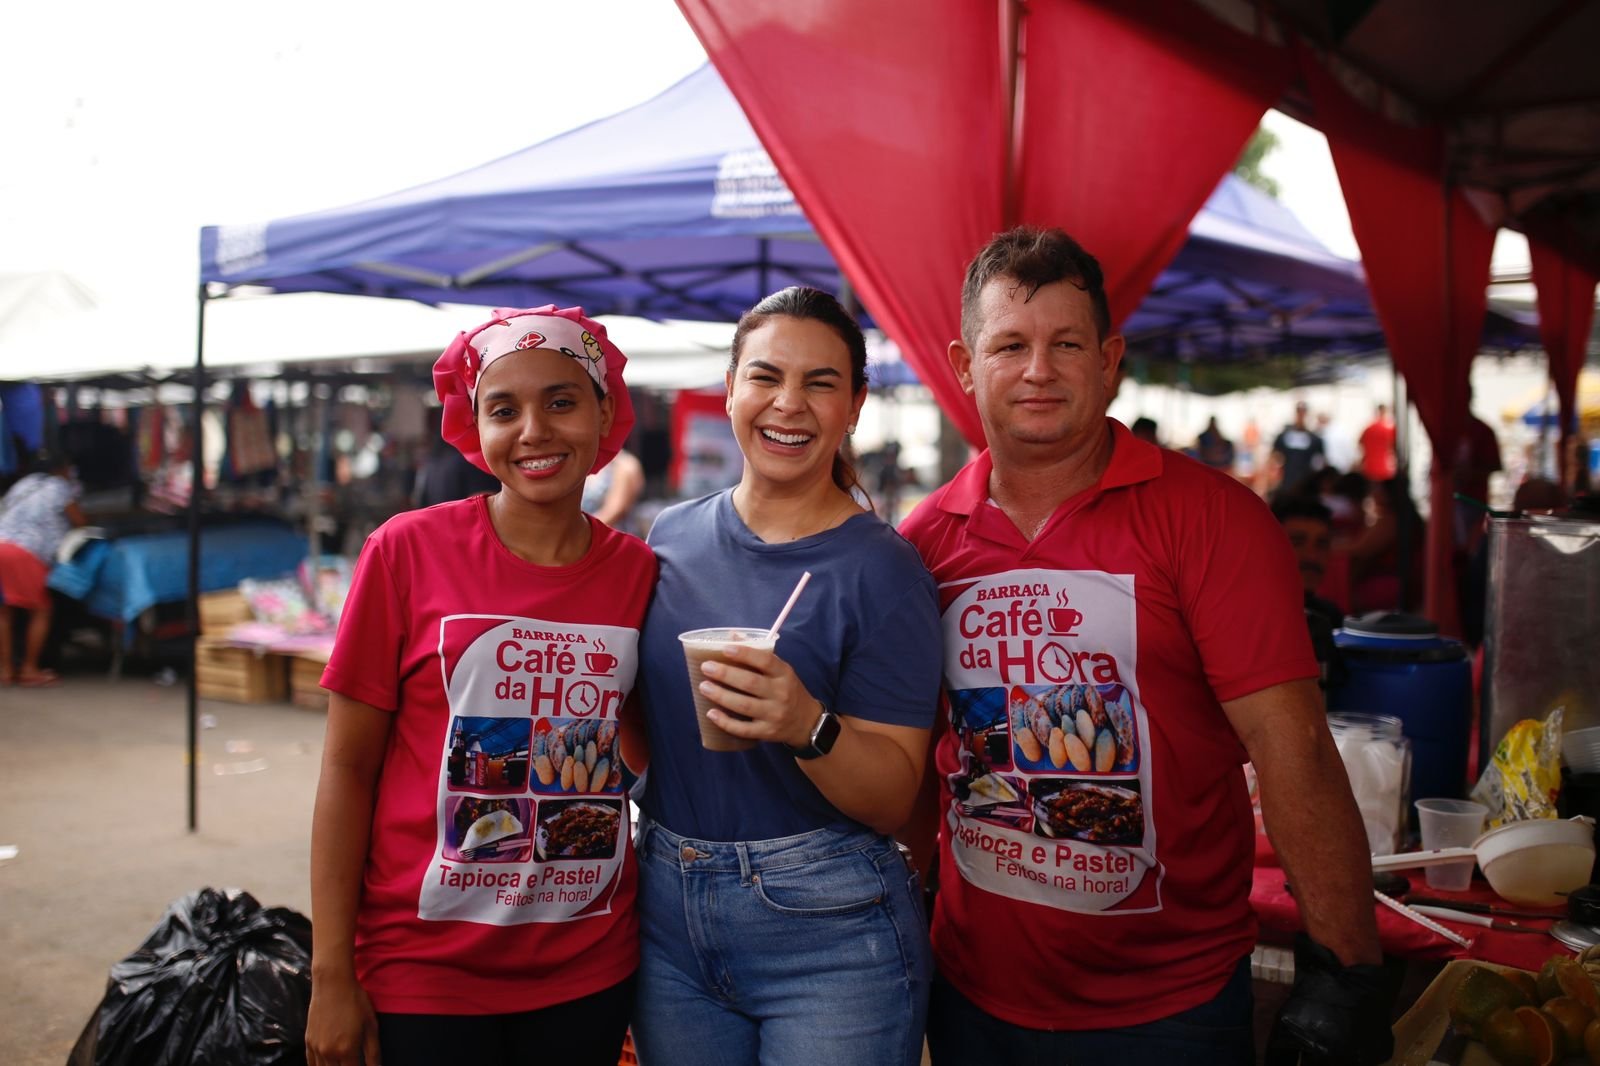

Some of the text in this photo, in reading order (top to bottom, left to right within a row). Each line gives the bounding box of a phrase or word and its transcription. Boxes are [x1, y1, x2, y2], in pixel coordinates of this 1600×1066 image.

[976, 583, 1050, 602] BARRACA
[959, 600, 1043, 639] Café
[512, 628, 588, 644] BARRACA
[496, 640, 576, 675] Café
[959, 643, 992, 669] da
[495, 676, 526, 700] da
[953, 822, 1135, 874] apioca e Pastel
[439, 864, 601, 892] Tapioca e Pastel
[996, 856, 1129, 893] Feitos na hora!
[495, 887, 593, 907] Feitos na hora!
